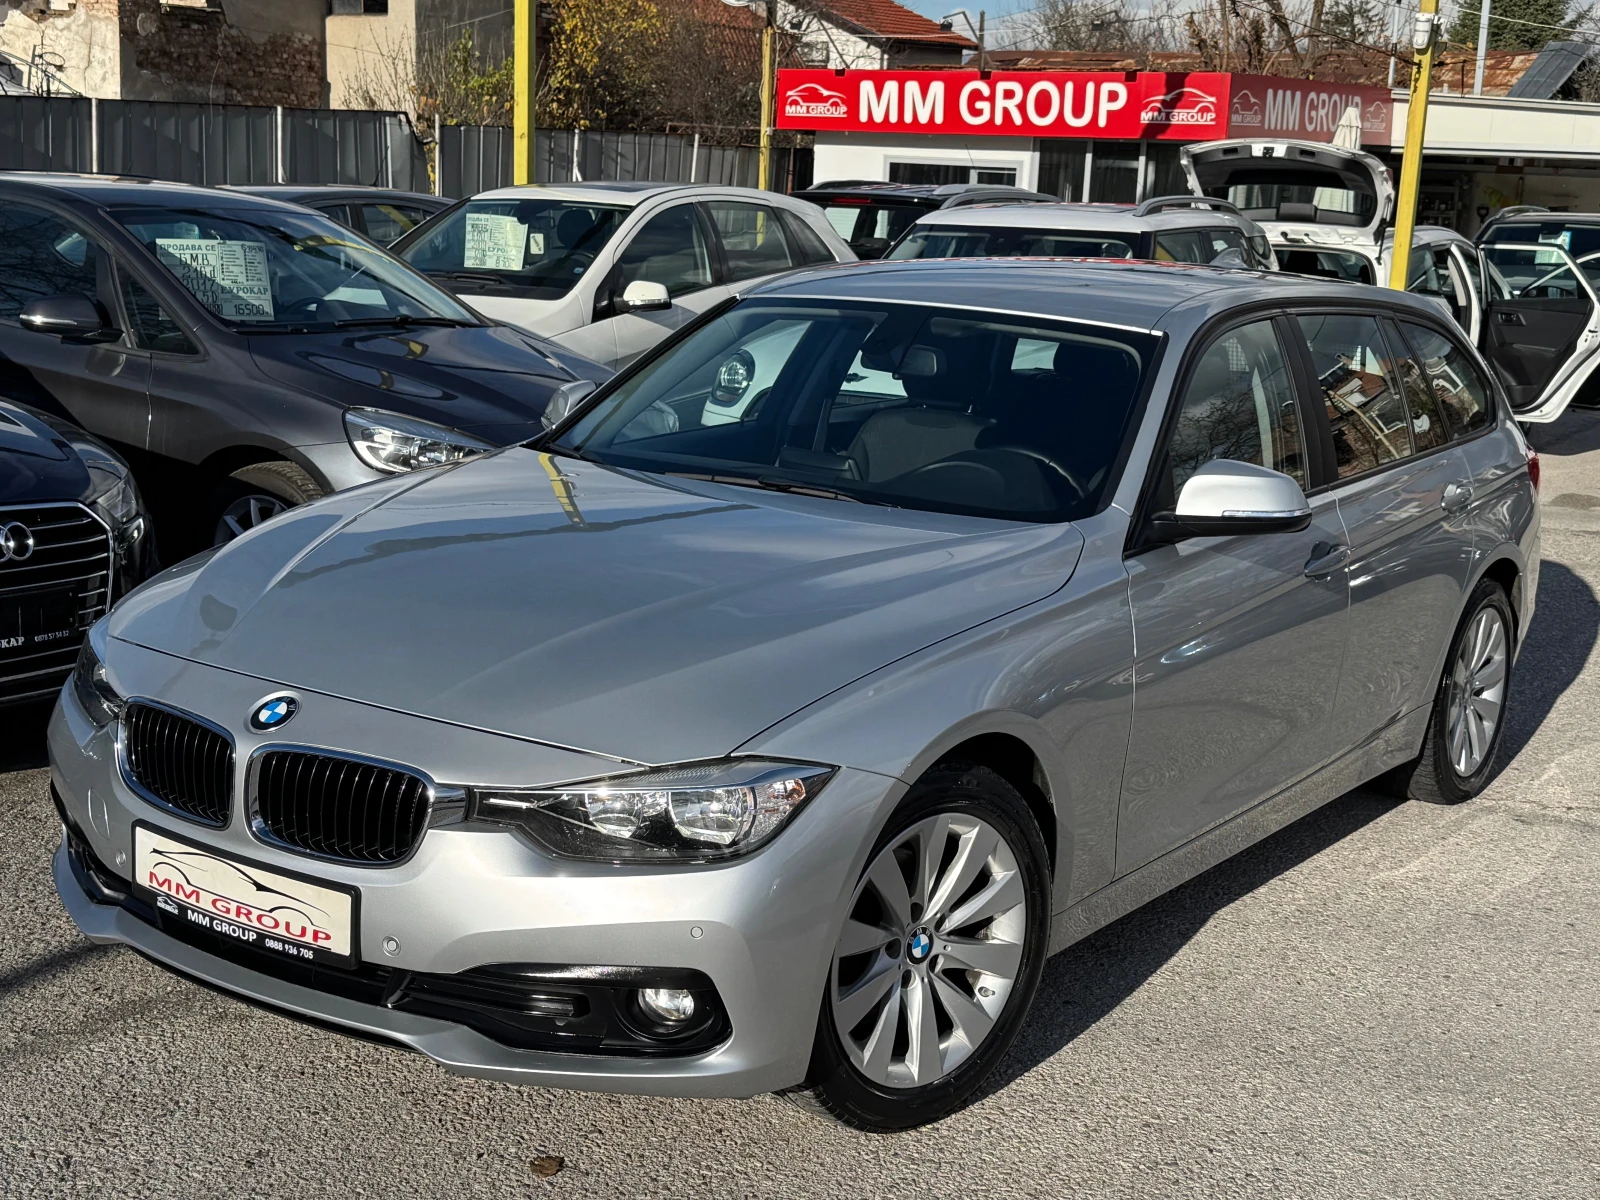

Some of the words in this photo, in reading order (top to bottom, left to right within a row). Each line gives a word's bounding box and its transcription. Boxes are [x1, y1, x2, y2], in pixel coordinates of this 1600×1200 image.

[859, 80, 945, 125] MM
[959, 81, 1128, 128] GROUP
[1264, 88, 1302, 131] MM
[785, 105, 807, 115] MM
[808, 106, 848, 116] GROUP
[1141, 111, 1166, 121] MM
[1169, 112, 1216, 122] GROUP
[1243, 114, 1262, 123] GROUP
[160, 243, 203, 252] ПРОДАВА
[205, 244, 216, 252] СЕ
[182, 279, 216, 291] 2017
[233, 304, 265, 315] 16500
[0, 636, 25, 648] КАР
[148, 870, 200, 904] MM
[211, 898, 332, 943] GROUP
[187, 909, 210, 928] MM
[212, 919, 257, 942] GROUP
[264, 938, 283, 951] 0888
[284, 944, 298, 955] 936
[299, 948, 314, 959] 705
